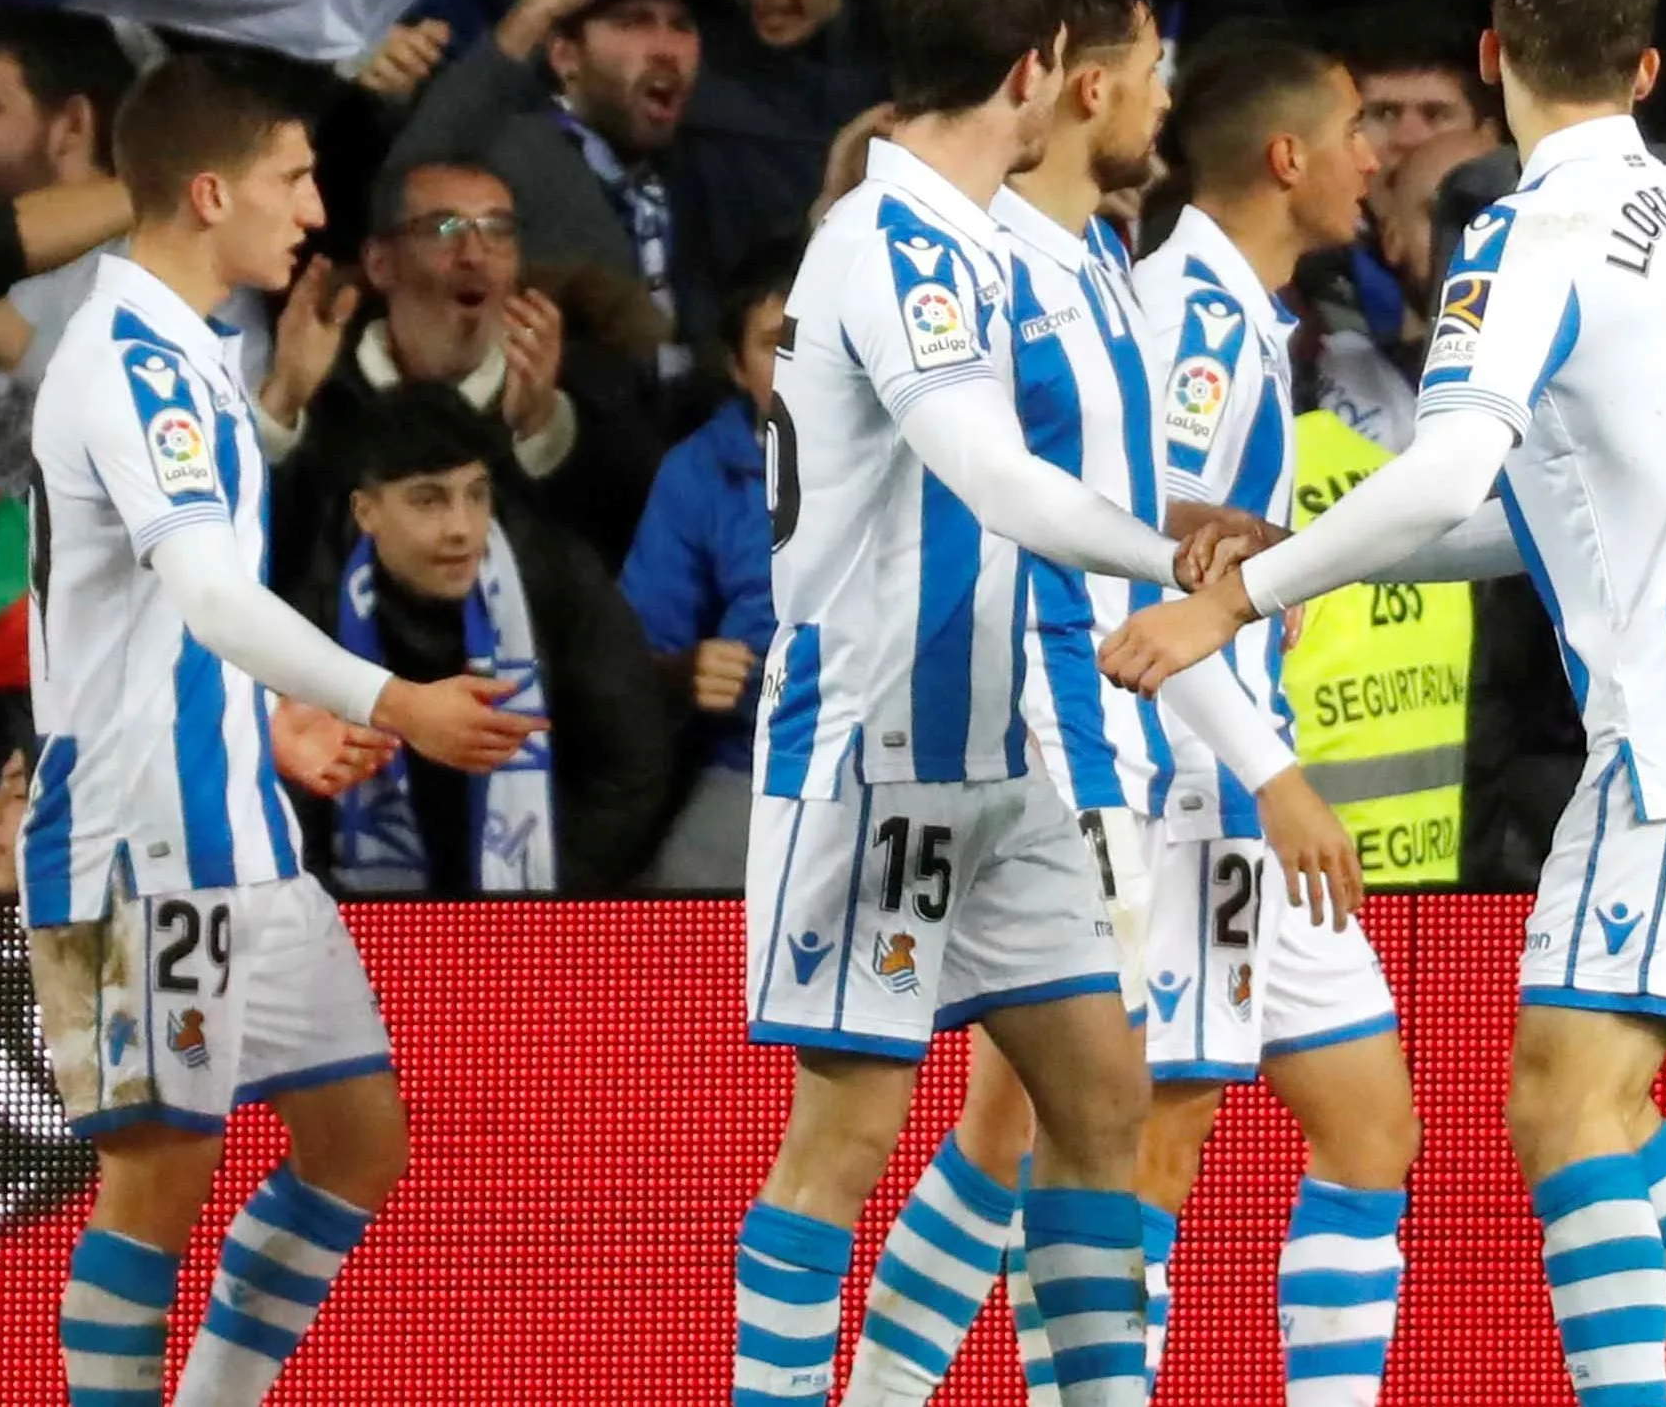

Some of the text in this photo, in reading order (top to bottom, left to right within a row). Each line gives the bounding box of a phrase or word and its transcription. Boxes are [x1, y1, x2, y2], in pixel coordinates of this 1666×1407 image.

[1023, 306, 1083, 339] macron
[920, 336, 966, 356] LaLiga
[1165, 413, 1210, 437] LaLiga
[165, 465, 209, 482] LaLiga
[873, 816, 952, 923] 15
[154, 898, 232, 998] 29
